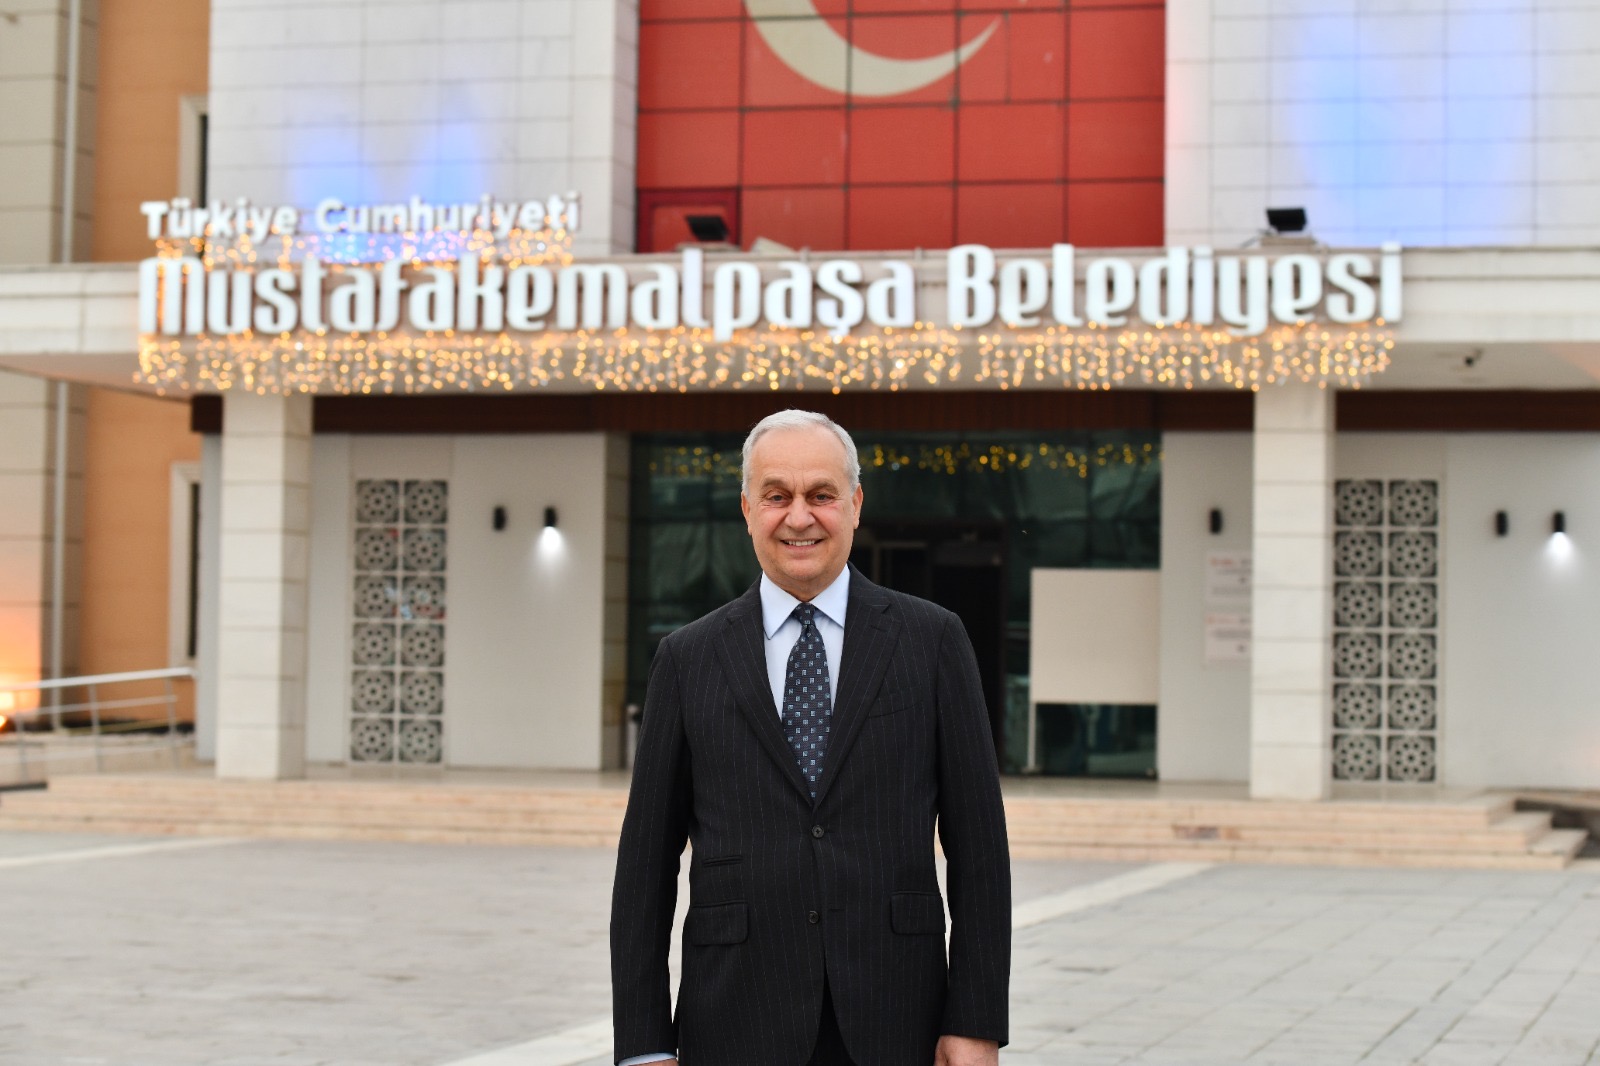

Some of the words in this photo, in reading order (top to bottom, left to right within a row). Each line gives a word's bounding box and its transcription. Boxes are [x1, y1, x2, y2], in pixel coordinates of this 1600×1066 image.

[141, 197, 297, 242] Türkiye
[315, 191, 579, 237] Cumhuriyeti
[139, 248, 916, 342] Mustafakemalpaşa
[947, 242, 1403, 336] Belediyesi
